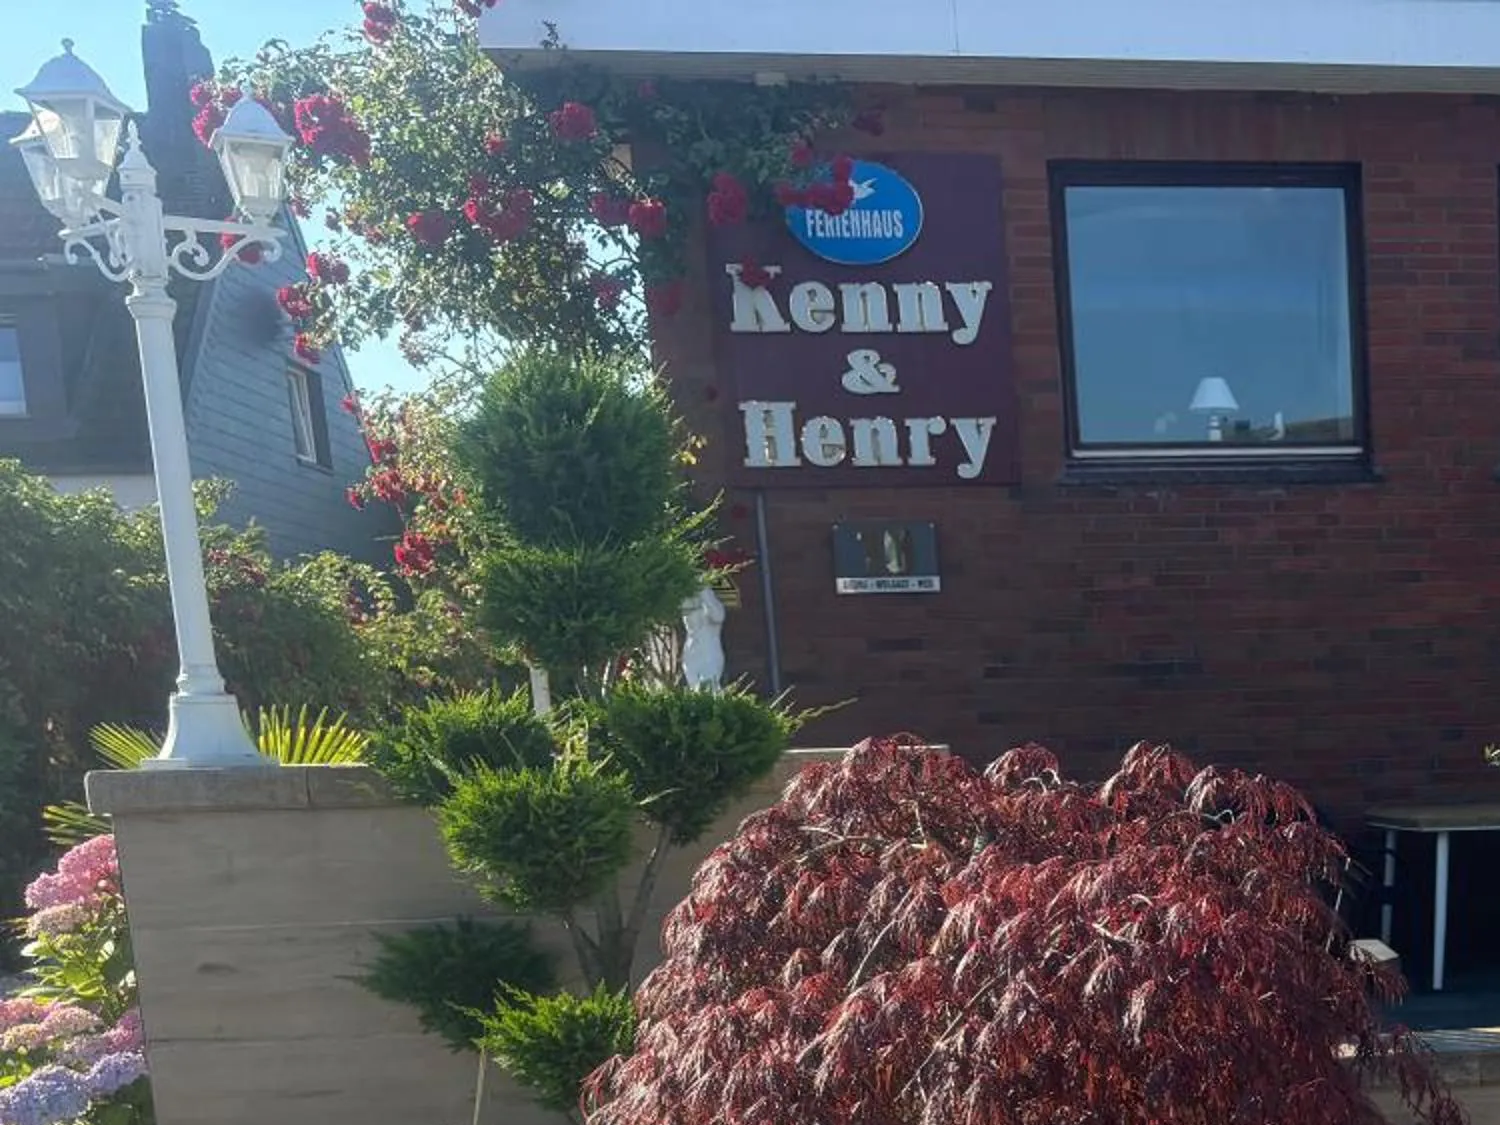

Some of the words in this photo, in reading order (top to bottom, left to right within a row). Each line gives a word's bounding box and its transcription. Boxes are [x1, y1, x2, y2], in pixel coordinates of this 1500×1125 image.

[805, 208, 904, 239] FERIENHAUS
[725, 262, 993, 345] Kenny
[841, 349, 900, 394] &
[738, 400, 997, 479] Henry
